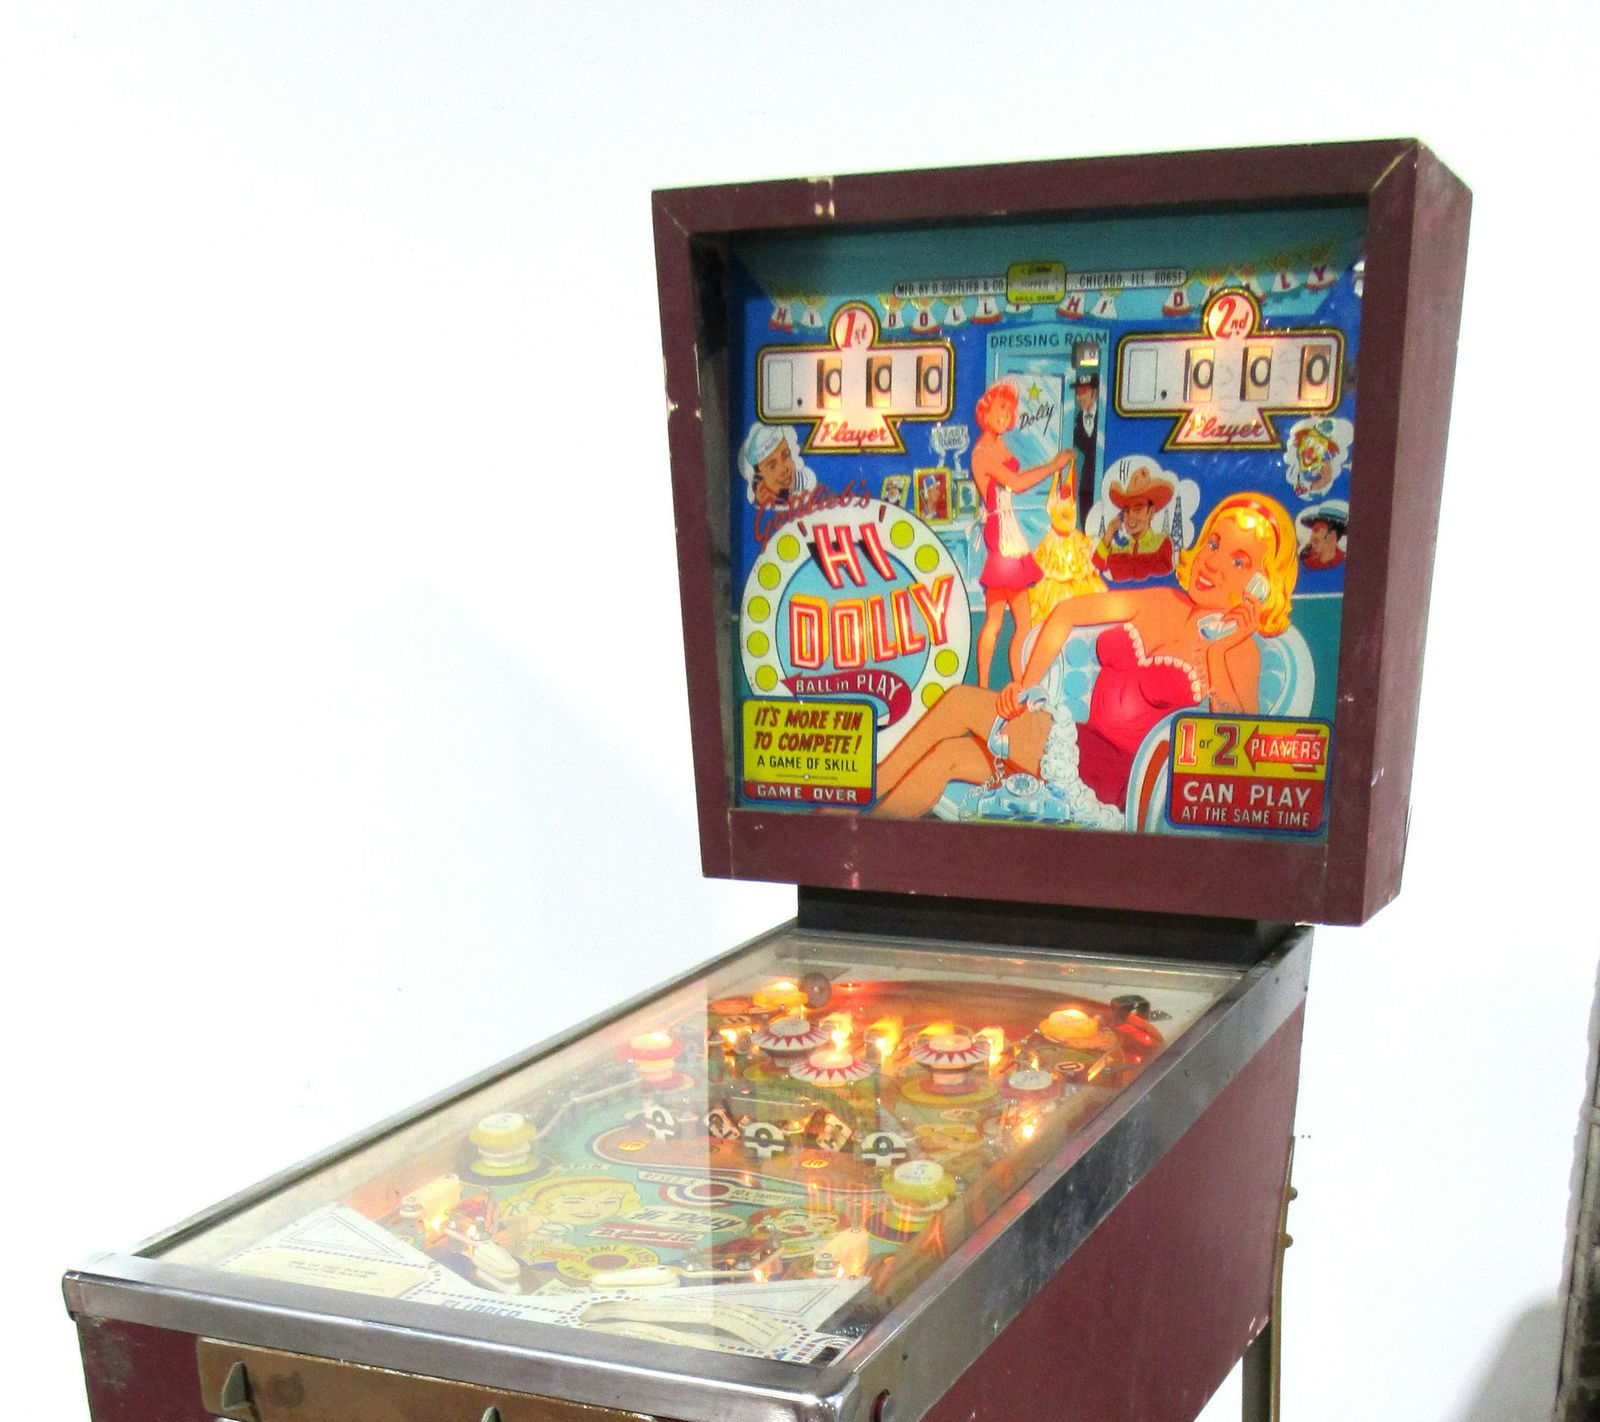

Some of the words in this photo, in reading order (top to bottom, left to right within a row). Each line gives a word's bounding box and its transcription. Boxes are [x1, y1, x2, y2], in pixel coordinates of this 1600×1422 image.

[1216, 296, 1250, 338] 2nd
[990, 333, 1060, 348] DRESSING
[1065, 332, 1107, 345] ROOM
[1019, 401, 1056, 436] Dolly
[1184, 416, 1266, 442] Player
[819, 420, 889, 447] Player
[812, 521, 897, 590] HI
[788, 573, 955, 671] DOLLY
[795, 678, 831, 695] BALL
[835, 679, 850, 692] in
[856, 673, 904, 701] PLAY
[754, 706, 779, 728] IT'S
[784, 708, 829, 730] MORE
[833, 709, 864, 732] FUN
[754, 731, 772, 750] TO
[777, 732, 863, 756] COMPETE!
[1178, 721, 1198, 766] 1
[1200, 736, 1213, 749] or
[1212, 723, 1241, 768] 2
[1251, 737, 1322, 761] PLAYERS
[757, 755, 766, 767] A
[769, 756, 802, 770] GAME
[806, 757, 821, 770] OF
[824, 758, 859, 773] SKILL
[757, 784, 802, 799] GAME
[812, 786, 859, 801] OVER
[1183, 780, 1234, 804] CAN
[1249, 783, 1311, 809] PLAY
[1181, 804, 1199, 820] AT
[1205, 806, 1227, 821] THE
[1233, 808, 1270, 824] SAME
[1278, 810, 1310, 827] TIME
